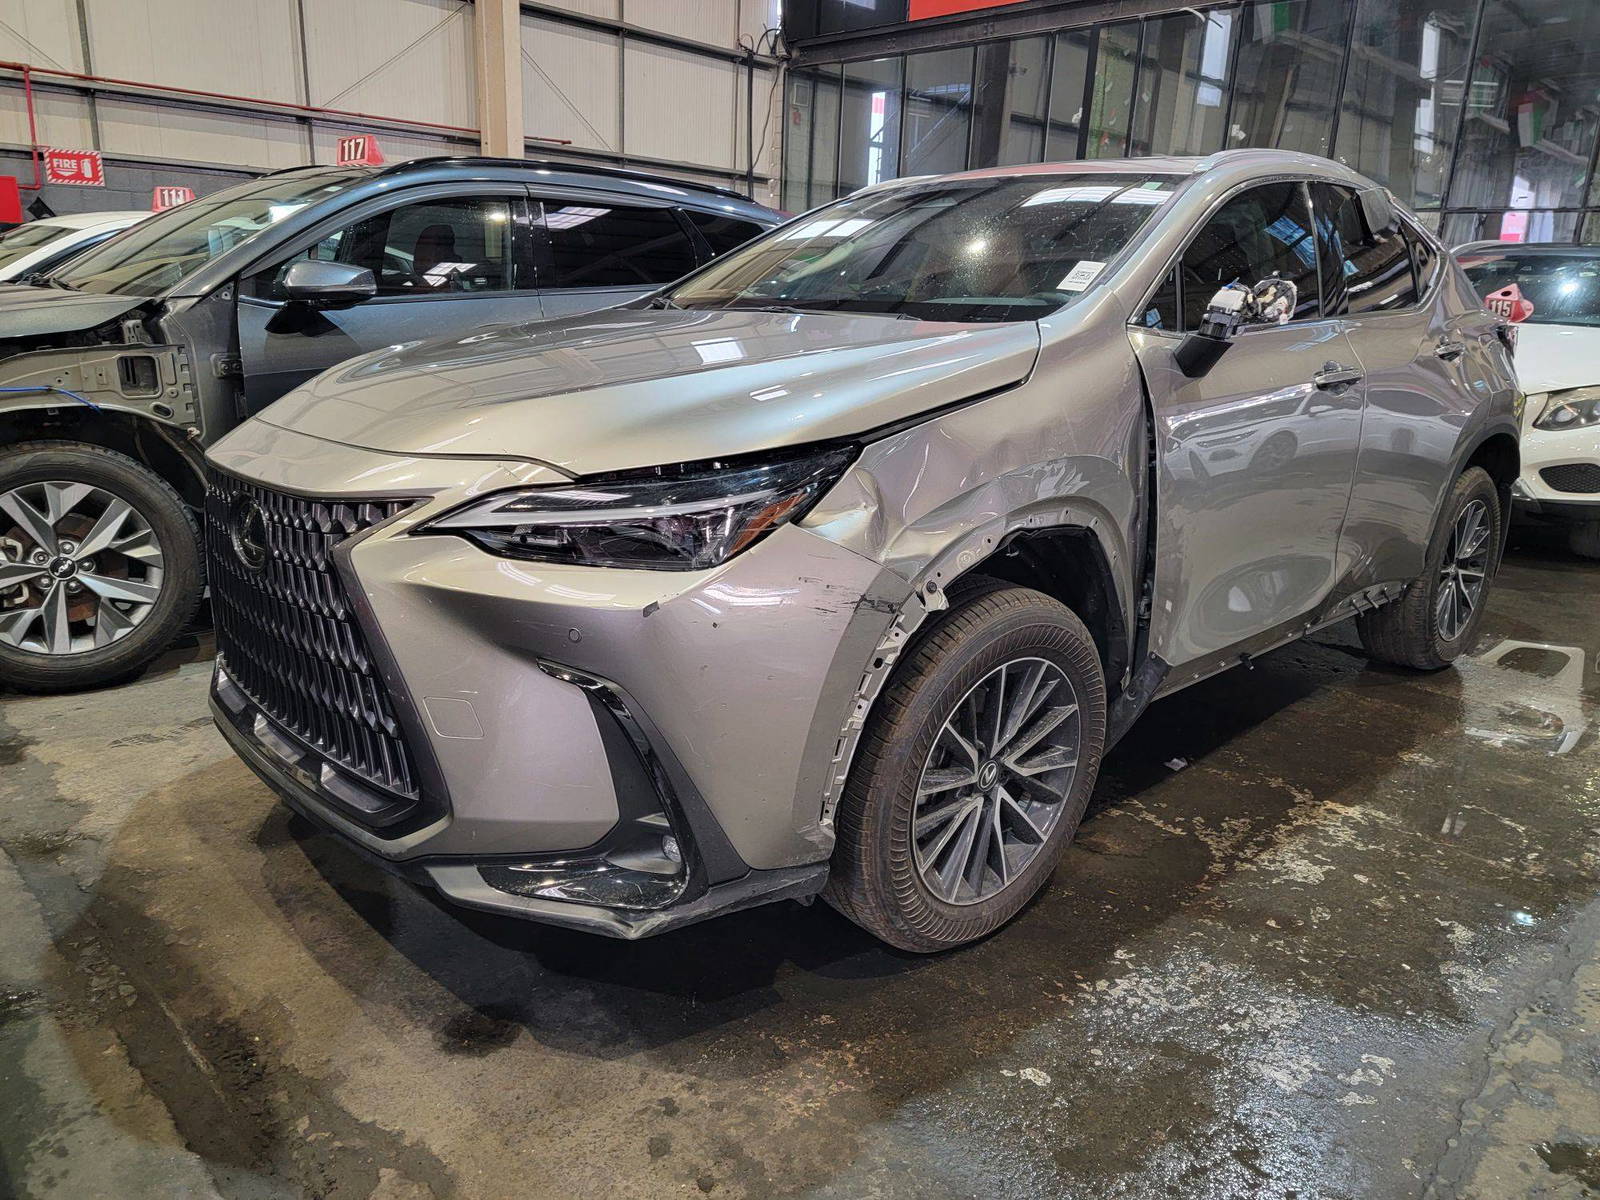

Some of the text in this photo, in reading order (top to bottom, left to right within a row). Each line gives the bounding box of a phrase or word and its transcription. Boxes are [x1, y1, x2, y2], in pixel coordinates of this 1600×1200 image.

[343, 138, 364, 161] 117
[53, 158, 78, 168] FIRE
[1490, 300, 1511, 317] 115
